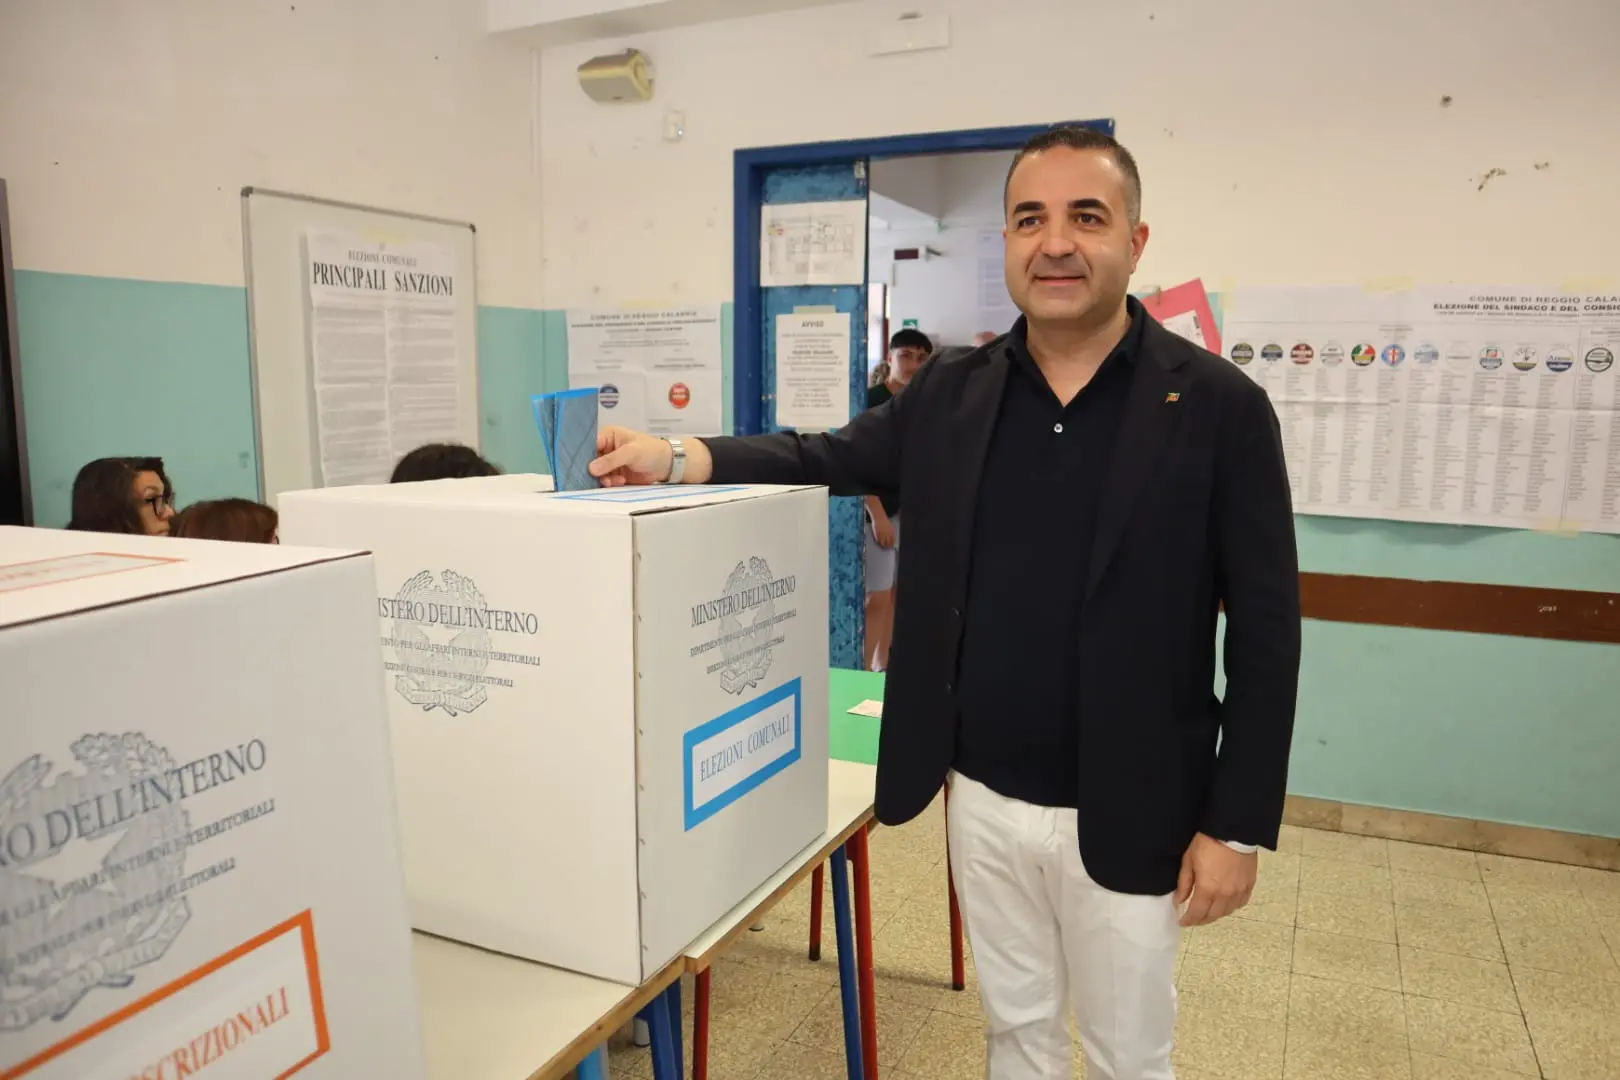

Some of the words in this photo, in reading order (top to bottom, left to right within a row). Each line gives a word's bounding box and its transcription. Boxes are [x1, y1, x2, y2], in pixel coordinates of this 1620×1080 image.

[313, 261, 387, 291] PRINCIPALI
[394, 271, 453, 297] SANZIONI
[1469, 295, 1517, 303] COMUNE
[1536, 296, 1581, 304] REGGIO
[1585, 296, 1620, 304] CALA
[1483, 303, 1501, 311] DEL
[428, 602, 539, 635] DELL'INTERNO
[691, 593, 741, 628] MINISTERO
[741, 575, 796, 611] DELL'INTERNO
[700, 740, 743, 783] ELEZIONI
[747, 714, 790, 754] COMUNALI
[45, 737, 267, 849] DELL'INTERNO
[185, 798, 277, 847] TERRITORIALI
